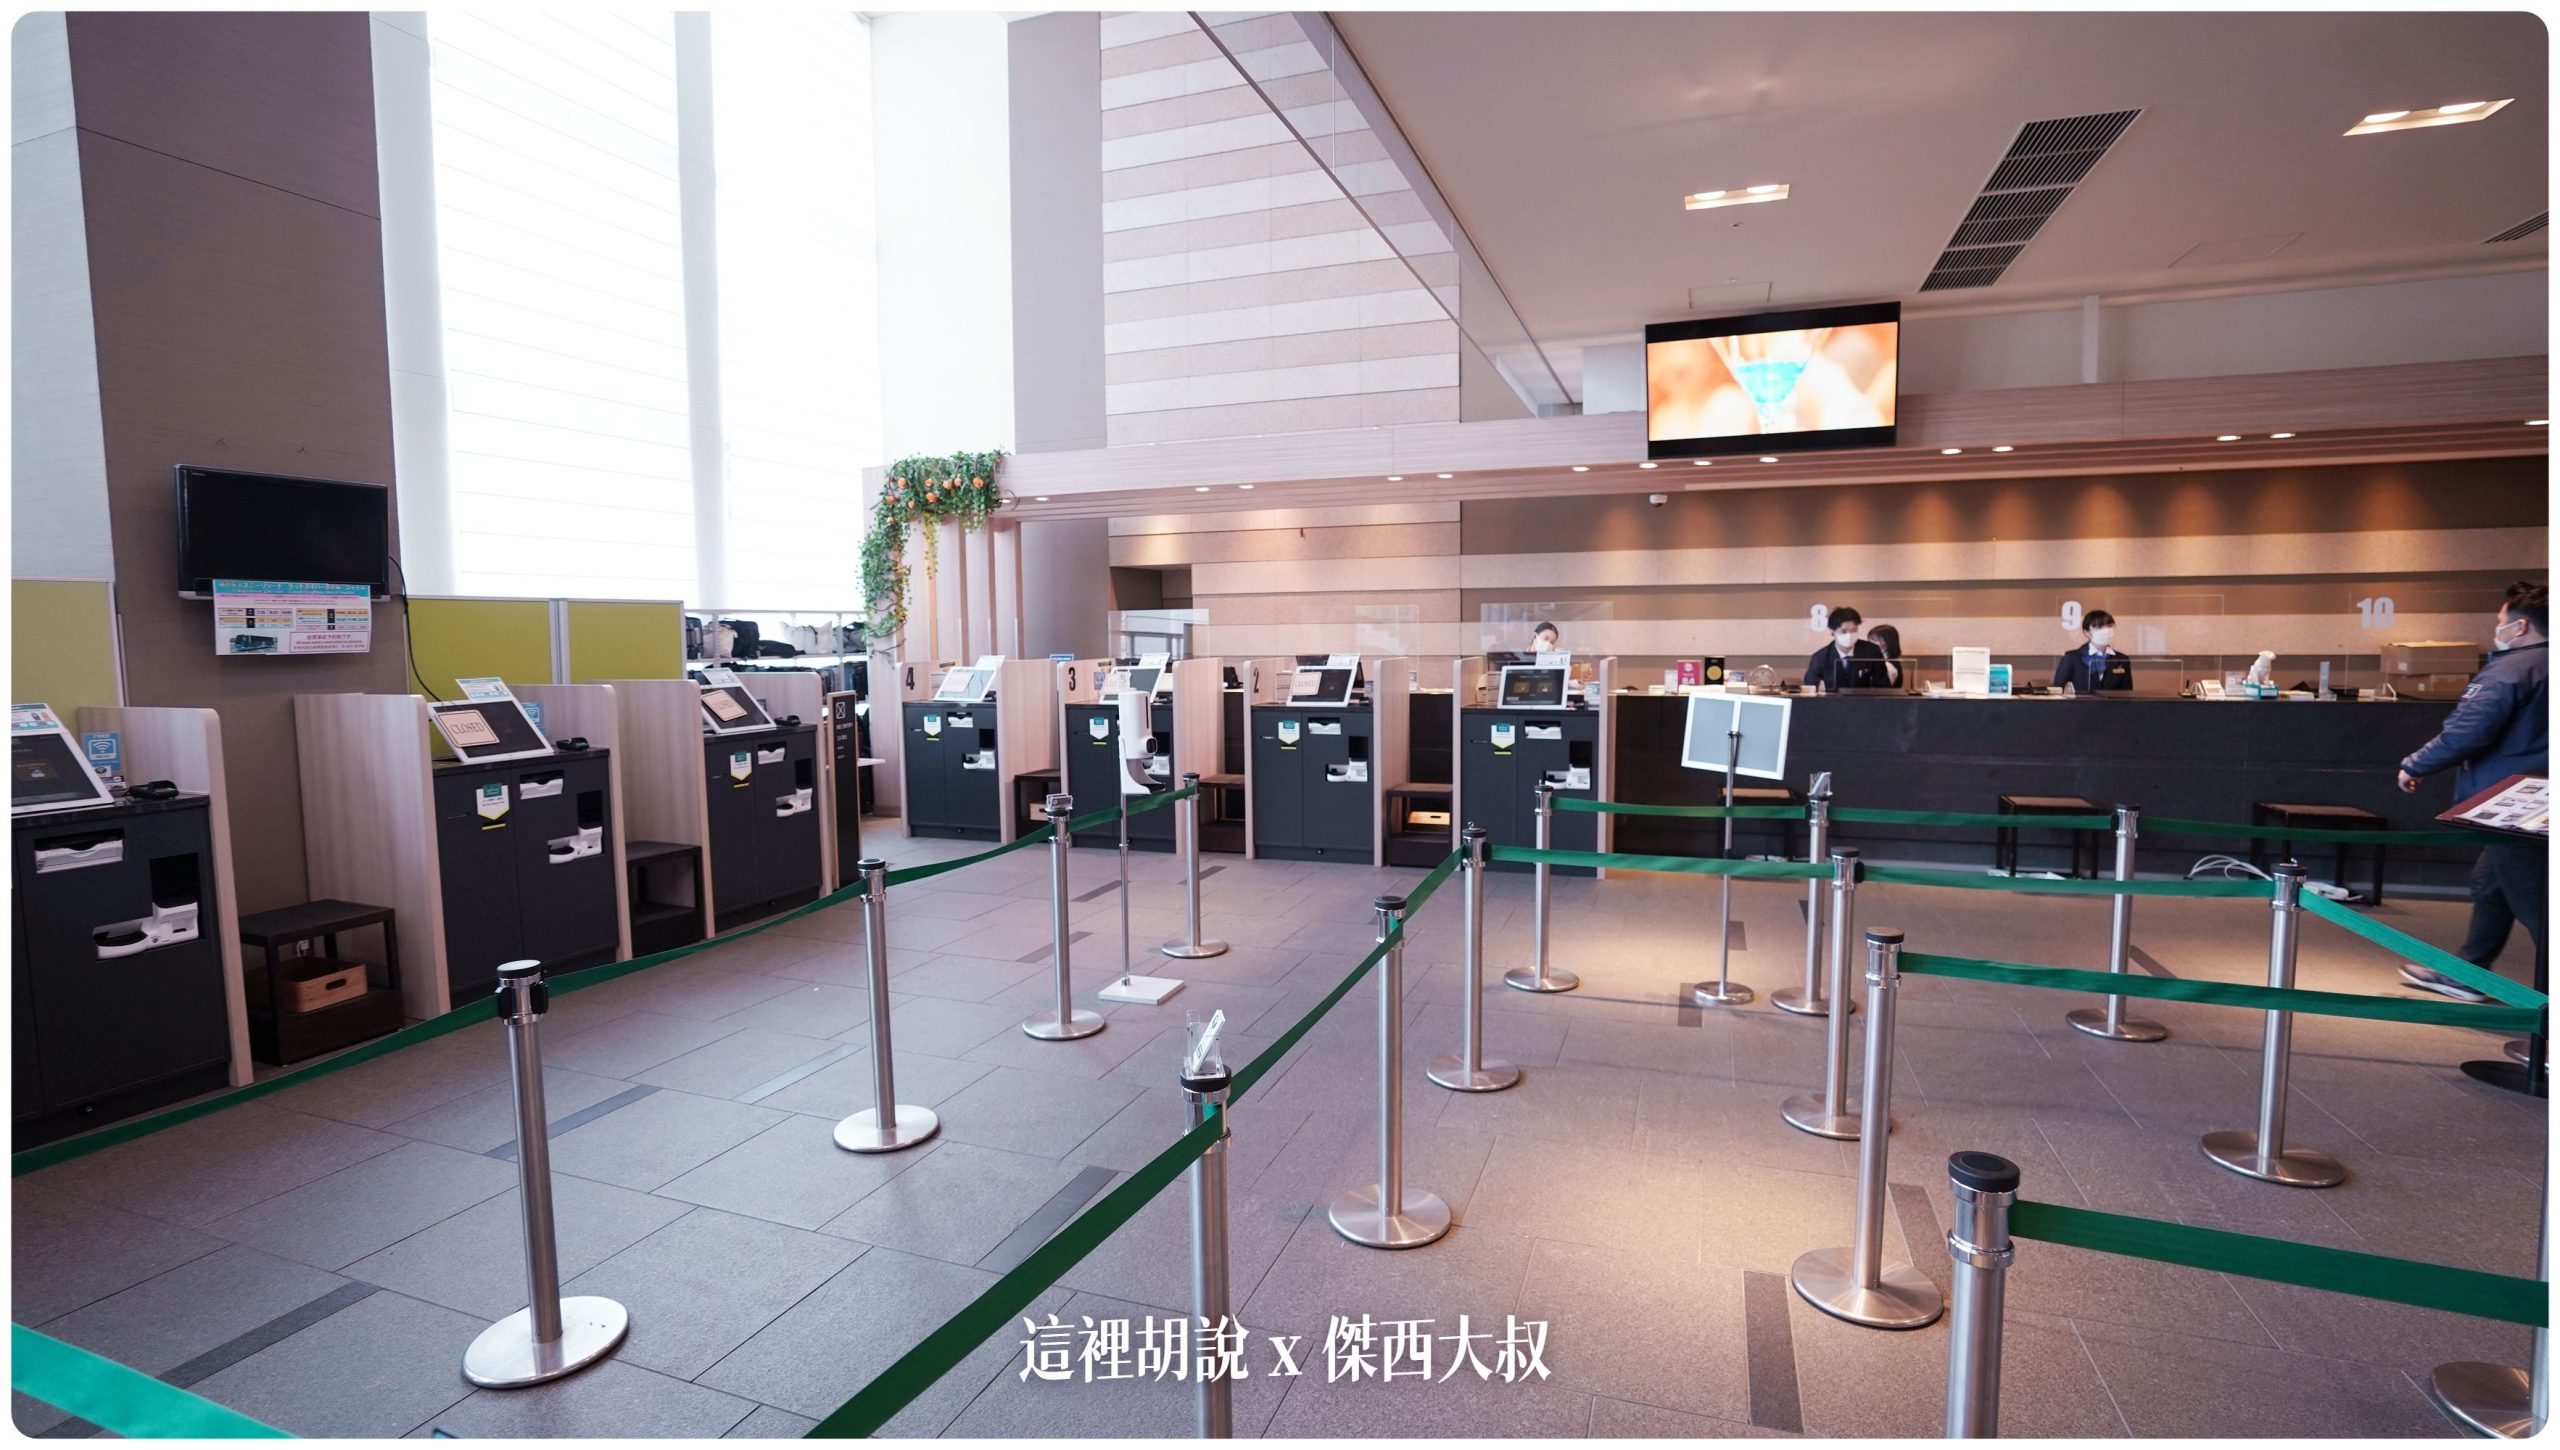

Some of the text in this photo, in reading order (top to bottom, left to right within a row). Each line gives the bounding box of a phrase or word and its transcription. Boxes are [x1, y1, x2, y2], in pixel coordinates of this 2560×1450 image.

[1811, 604, 1828, 632] 8
[2062, 600, 2081, 630] 9
[2356, 597, 2394, 629] 10
[906, 667, 915, 690] 4
[1068, 666, 1076, 691] 3
[1253, 667, 1260, 693] 2
[450, 722, 486, 734] CLOSED
